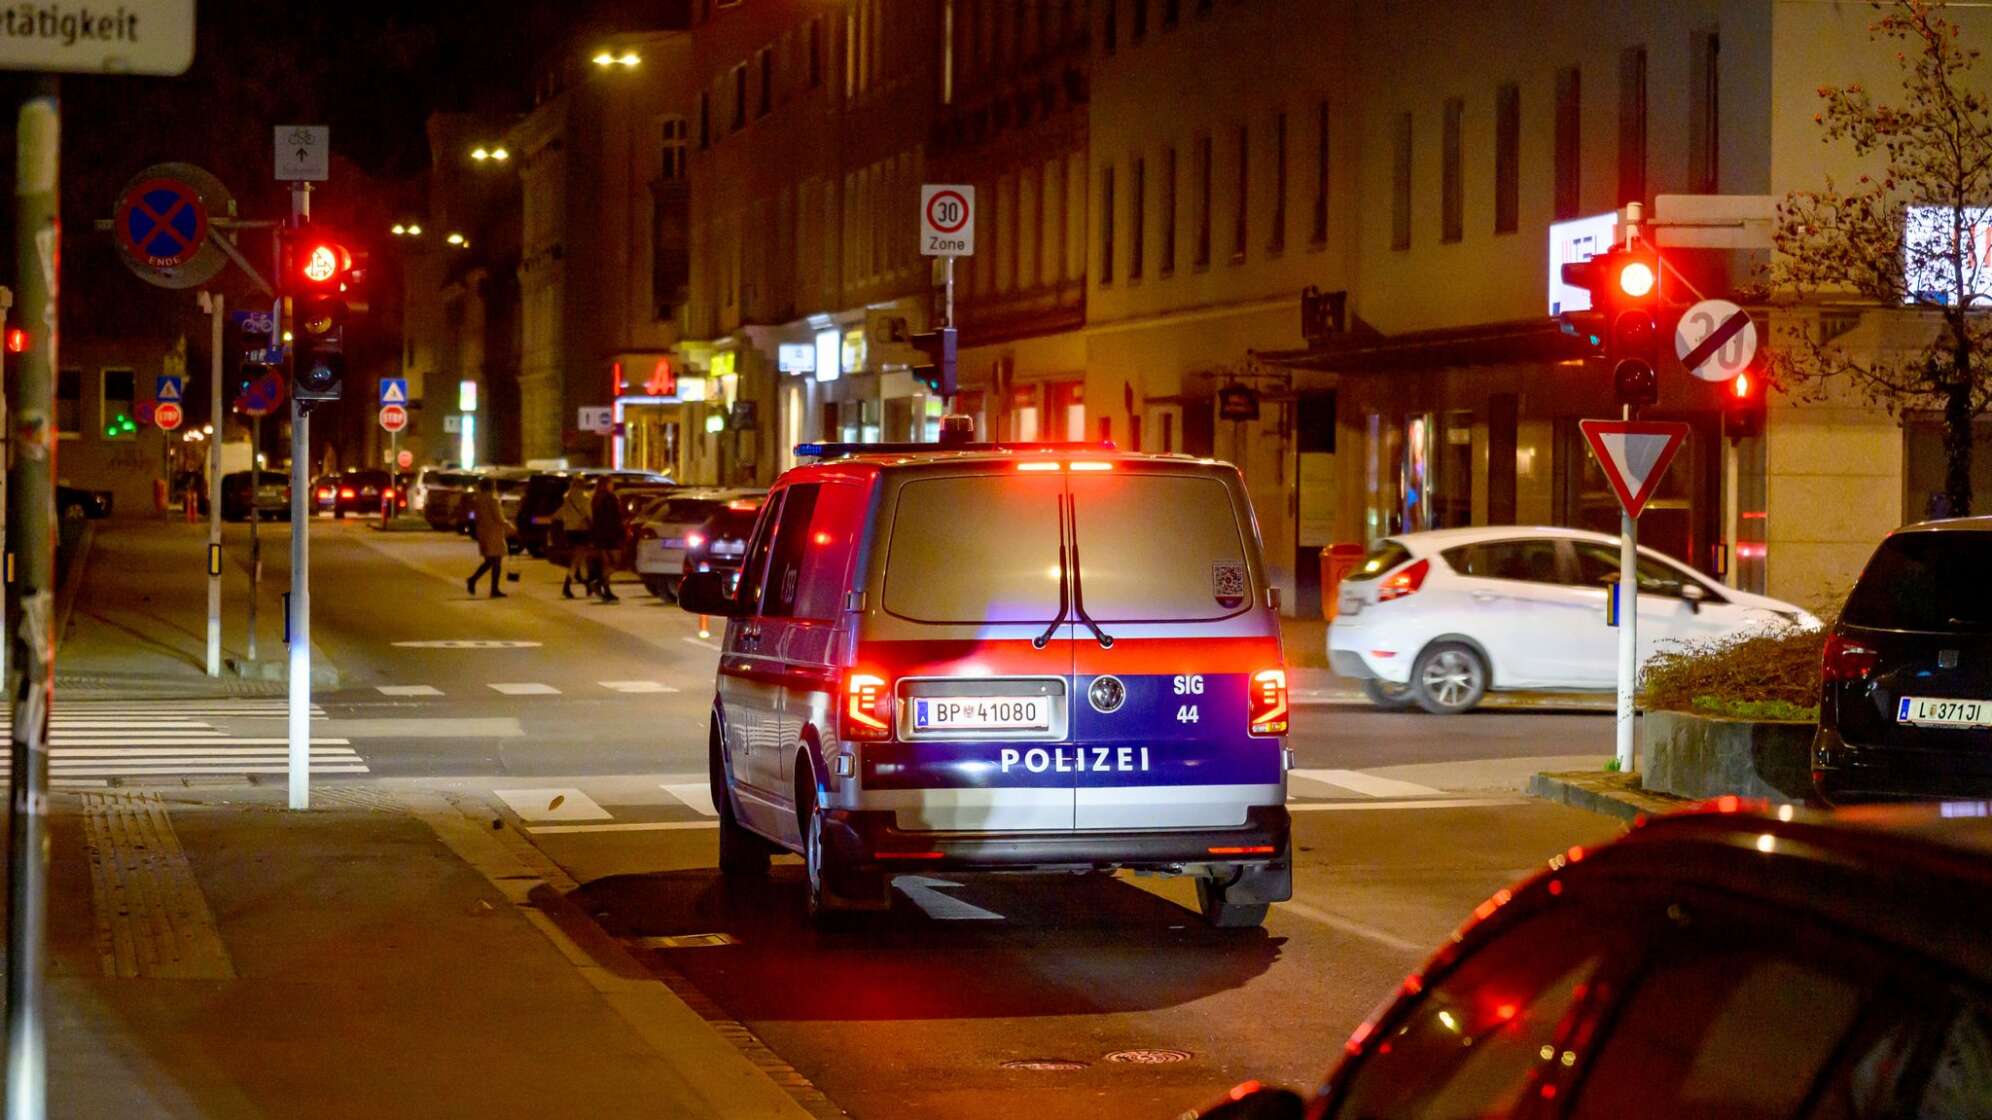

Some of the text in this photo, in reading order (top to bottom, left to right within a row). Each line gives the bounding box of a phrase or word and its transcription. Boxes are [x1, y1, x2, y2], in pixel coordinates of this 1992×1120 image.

[0, 4, 138, 46] tätigkeit
[938, 202, 958, 222] 30
[929, 236, 965, 250] Zone
[148, 255, 181, 267] ENDE
[1173, 675, 1204, 695] SIG
[937, 703, 961, 722] BP
[977, 702, 1036, 722] 41080
[1176, 704, 1199, 724] 44
[1919, 701, 1927, 719] L
[1937, 703, 1982, 722] 371JI
[1000, 746, 1149, 774] POLIZEI
